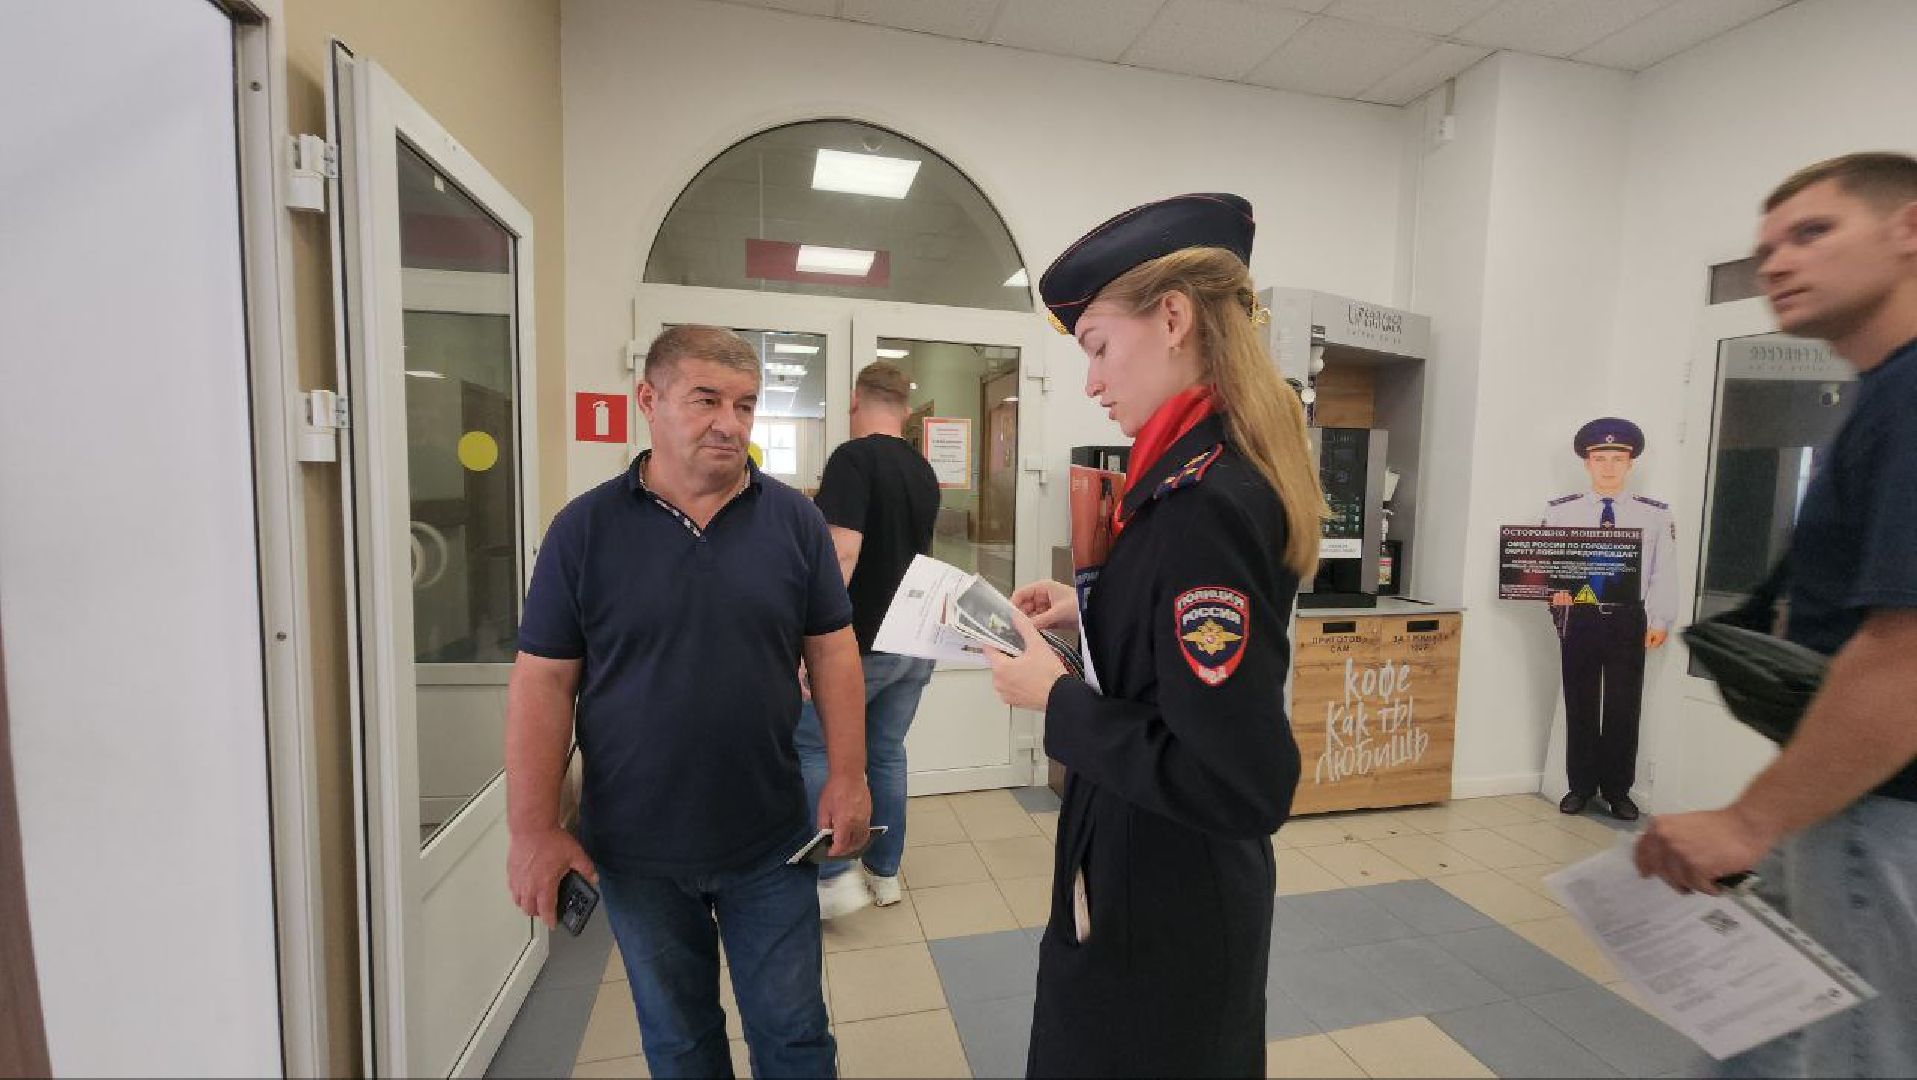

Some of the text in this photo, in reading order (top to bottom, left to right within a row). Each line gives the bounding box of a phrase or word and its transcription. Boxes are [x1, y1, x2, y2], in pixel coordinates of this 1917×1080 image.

[1532, 541, 1566, 550] РОССИИ
[1567, 542, 1580, 550] ПО
[1580, 542, 1637, 551] ГОРОДСКОМУ
[1177, 589, 1245, 610] ПОЛИЦИЯ
[1330, 645, 1351, 654] САМ
